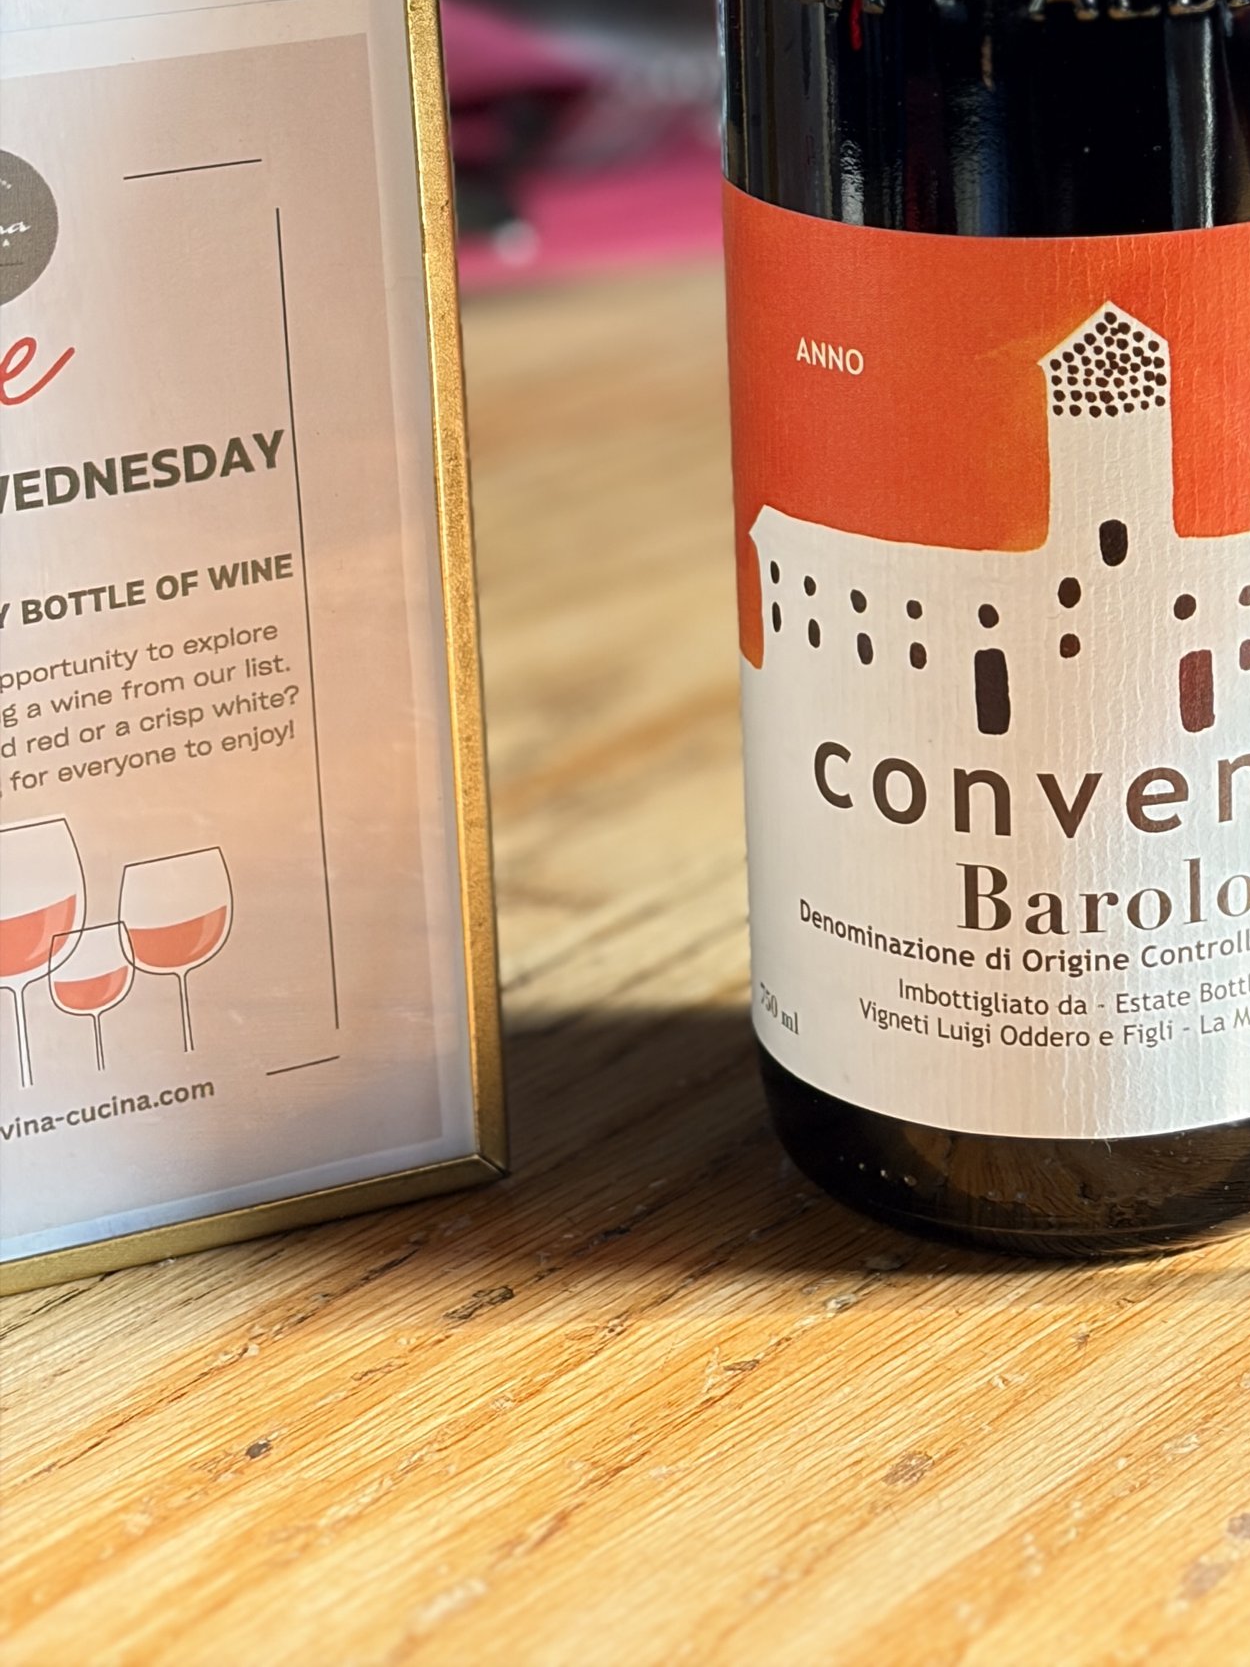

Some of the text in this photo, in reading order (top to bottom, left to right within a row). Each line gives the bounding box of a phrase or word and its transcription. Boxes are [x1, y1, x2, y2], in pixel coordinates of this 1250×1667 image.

[795, 336, 865, 376] ANNO
[21, 579, 147, 625] BOTTLE
[156, 570, 199, 601] OF
[208, 553, 294, 590] WINE
[146, 643, 174, 663] to
[183, 624, 278, 655] explore
[27, 703, 42, 719] a
[51, 689, 113, 714] wine
[121, 676, 185, 701] from
[194, 665, 236, 687] our
[245, 654, 291, 679] list.
[26, 727, 69, 754] red
[79, 724, 106, 744] or
[115, 720, 131, 737] a
[139, 706, 204, 733] crisp
[212, 685, 300, 718] white?
[10, 720, 295, 791] for everyone to enjoy!
[800, 898, 975, 968] Denominazione
[985, 946, 1011, 971] di
[1022, 948, 1130, 978] Origine
[760, 981, 799, 1035] 750 ml
[860, 998, 929, 1035] Vigneti
[937, 1017, 991, 1048] Luigi
[1000, 1025, 1090, 1047] Oddero
[1099, 1030, 1114, 1047] e
[1123, 1020, 1173, 1048] Figli
[1200, 1014, 1225, 1035] La
[899, 978, 1049, 1017] Imbottigliato
[1057, 994, 1087, 1016] da
[1116, 988, 1191, 1015] Estate
